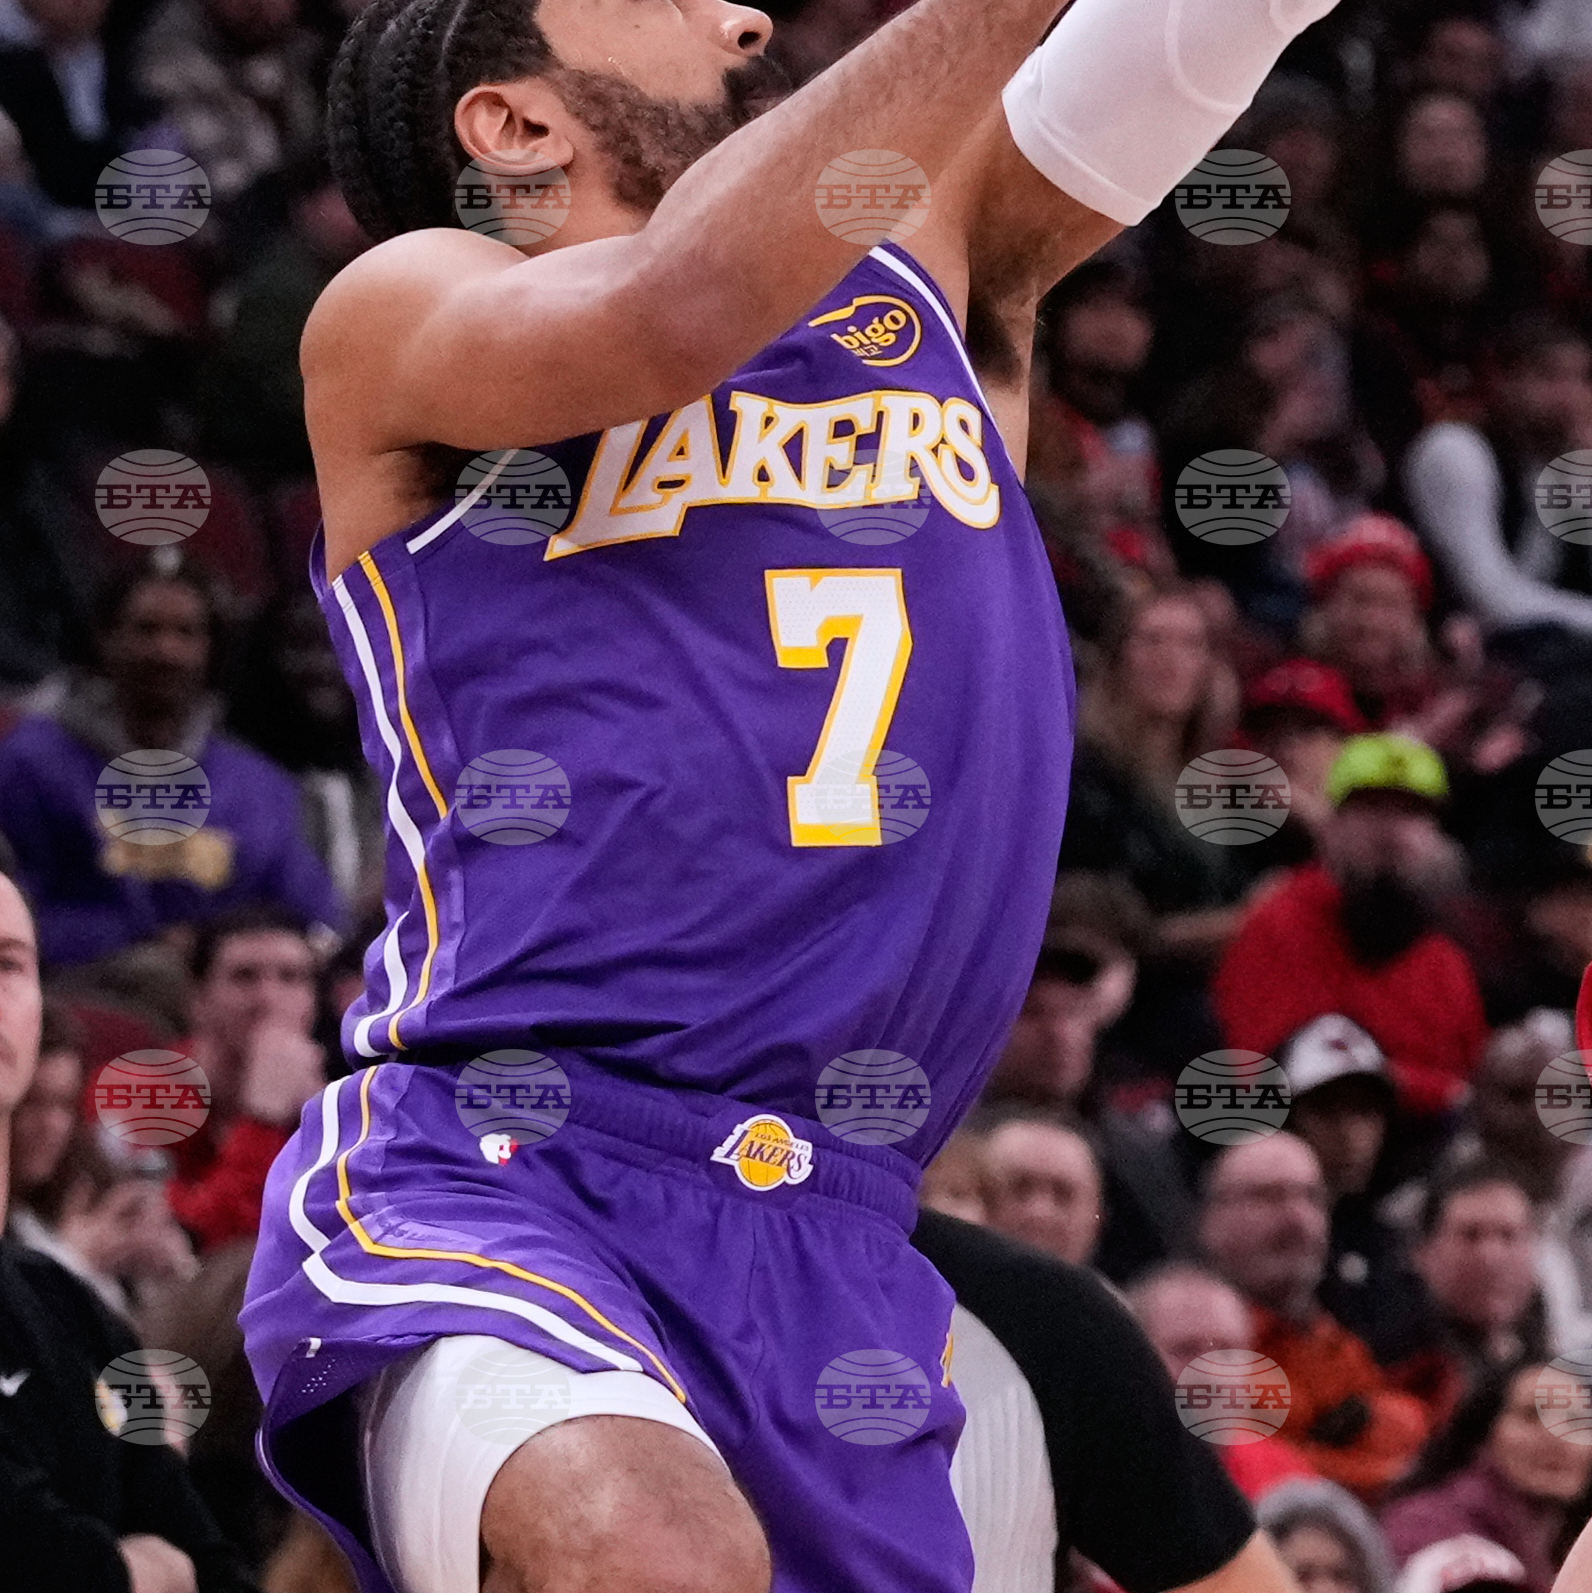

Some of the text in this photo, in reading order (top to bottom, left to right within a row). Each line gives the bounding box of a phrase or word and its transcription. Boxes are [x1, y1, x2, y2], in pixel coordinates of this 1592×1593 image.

[543, 390, 1000, 561] LAKERS
[764, 568, 913, 847] 7
[718, 1129, 810, 1180] LAKERS
